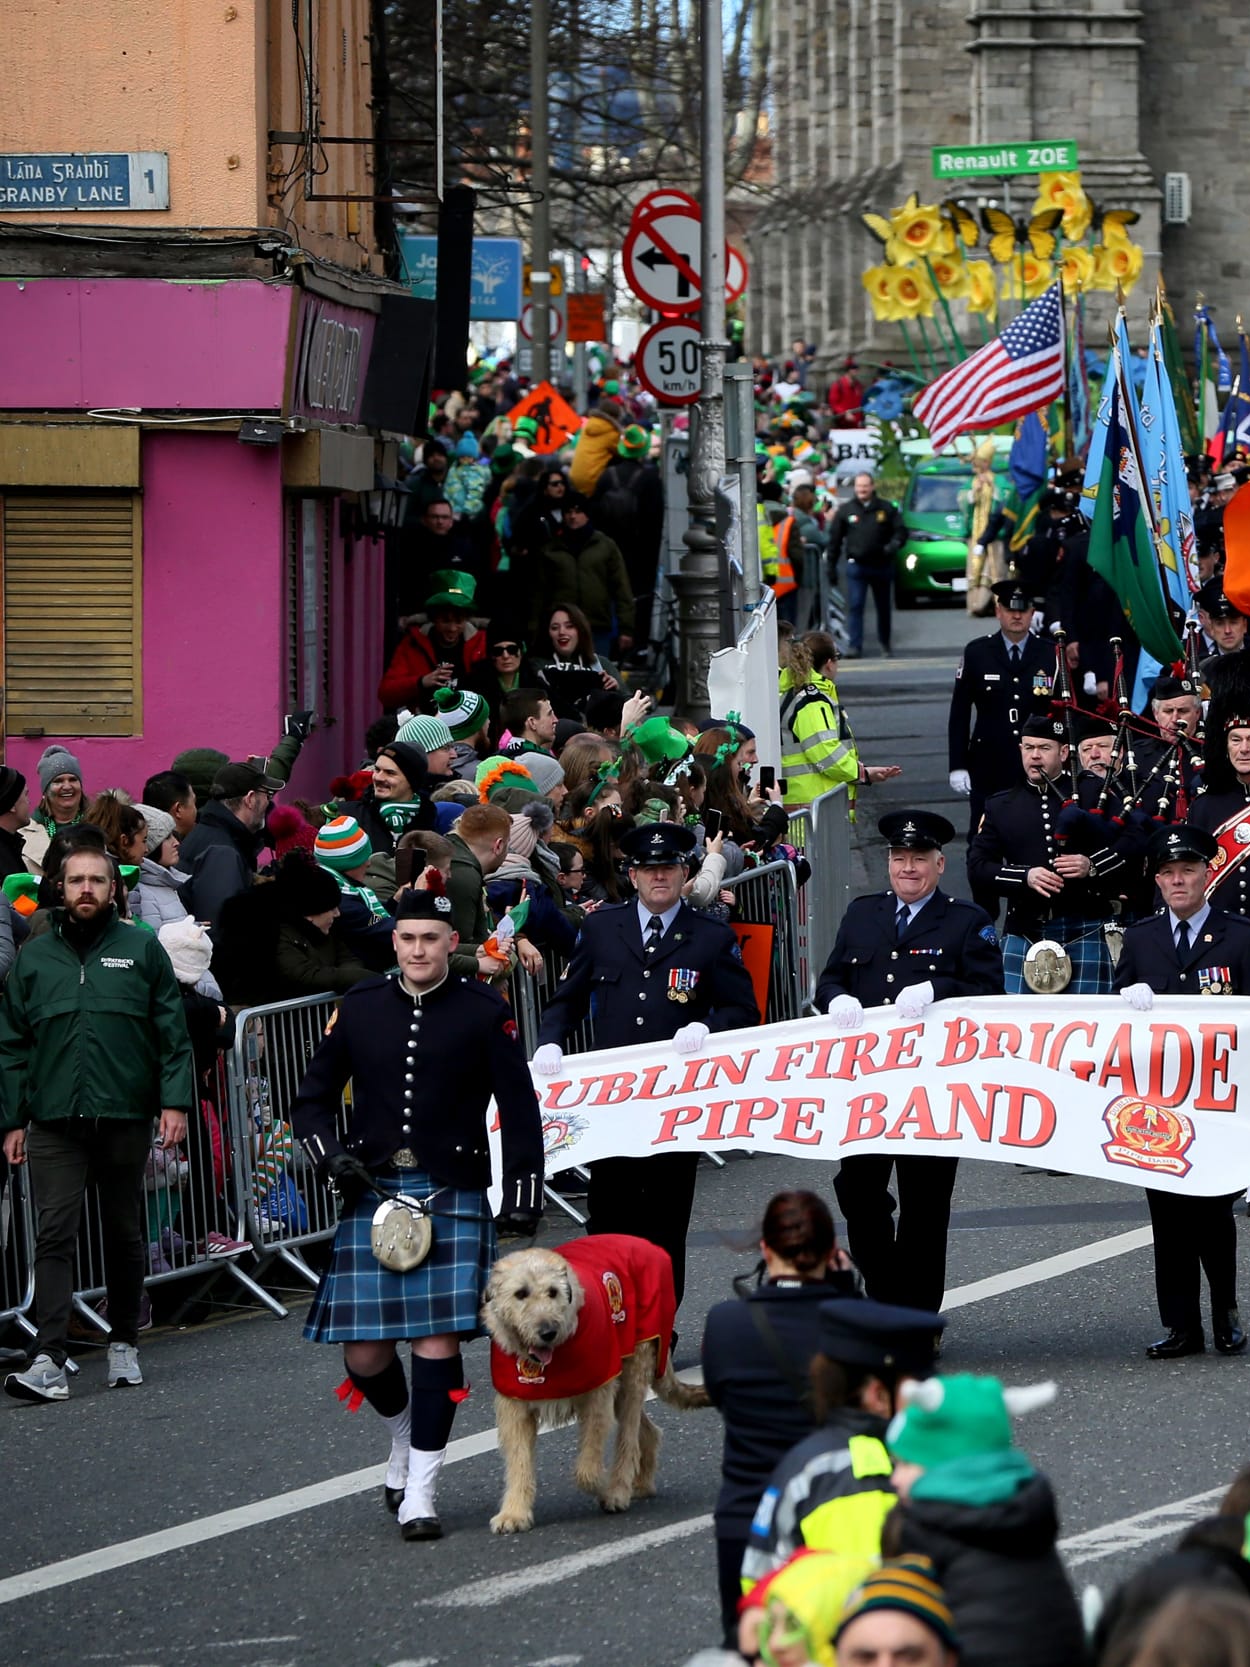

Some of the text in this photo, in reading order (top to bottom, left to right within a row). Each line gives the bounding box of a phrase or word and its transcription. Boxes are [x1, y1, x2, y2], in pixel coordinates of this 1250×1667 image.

[939, 147, 1069, 171] Renault ZOE
[78, 186, 124, 201] LANE
[144, 169, 154, 194] 1
[658, 339, 698, 375] 50
[663, 380, 696, 391] km/h
[535, 1016, 1238, 1112] UBLIN FIRE BRIGADE
[651, 1082, 1057, 1149] PIPE BAND
